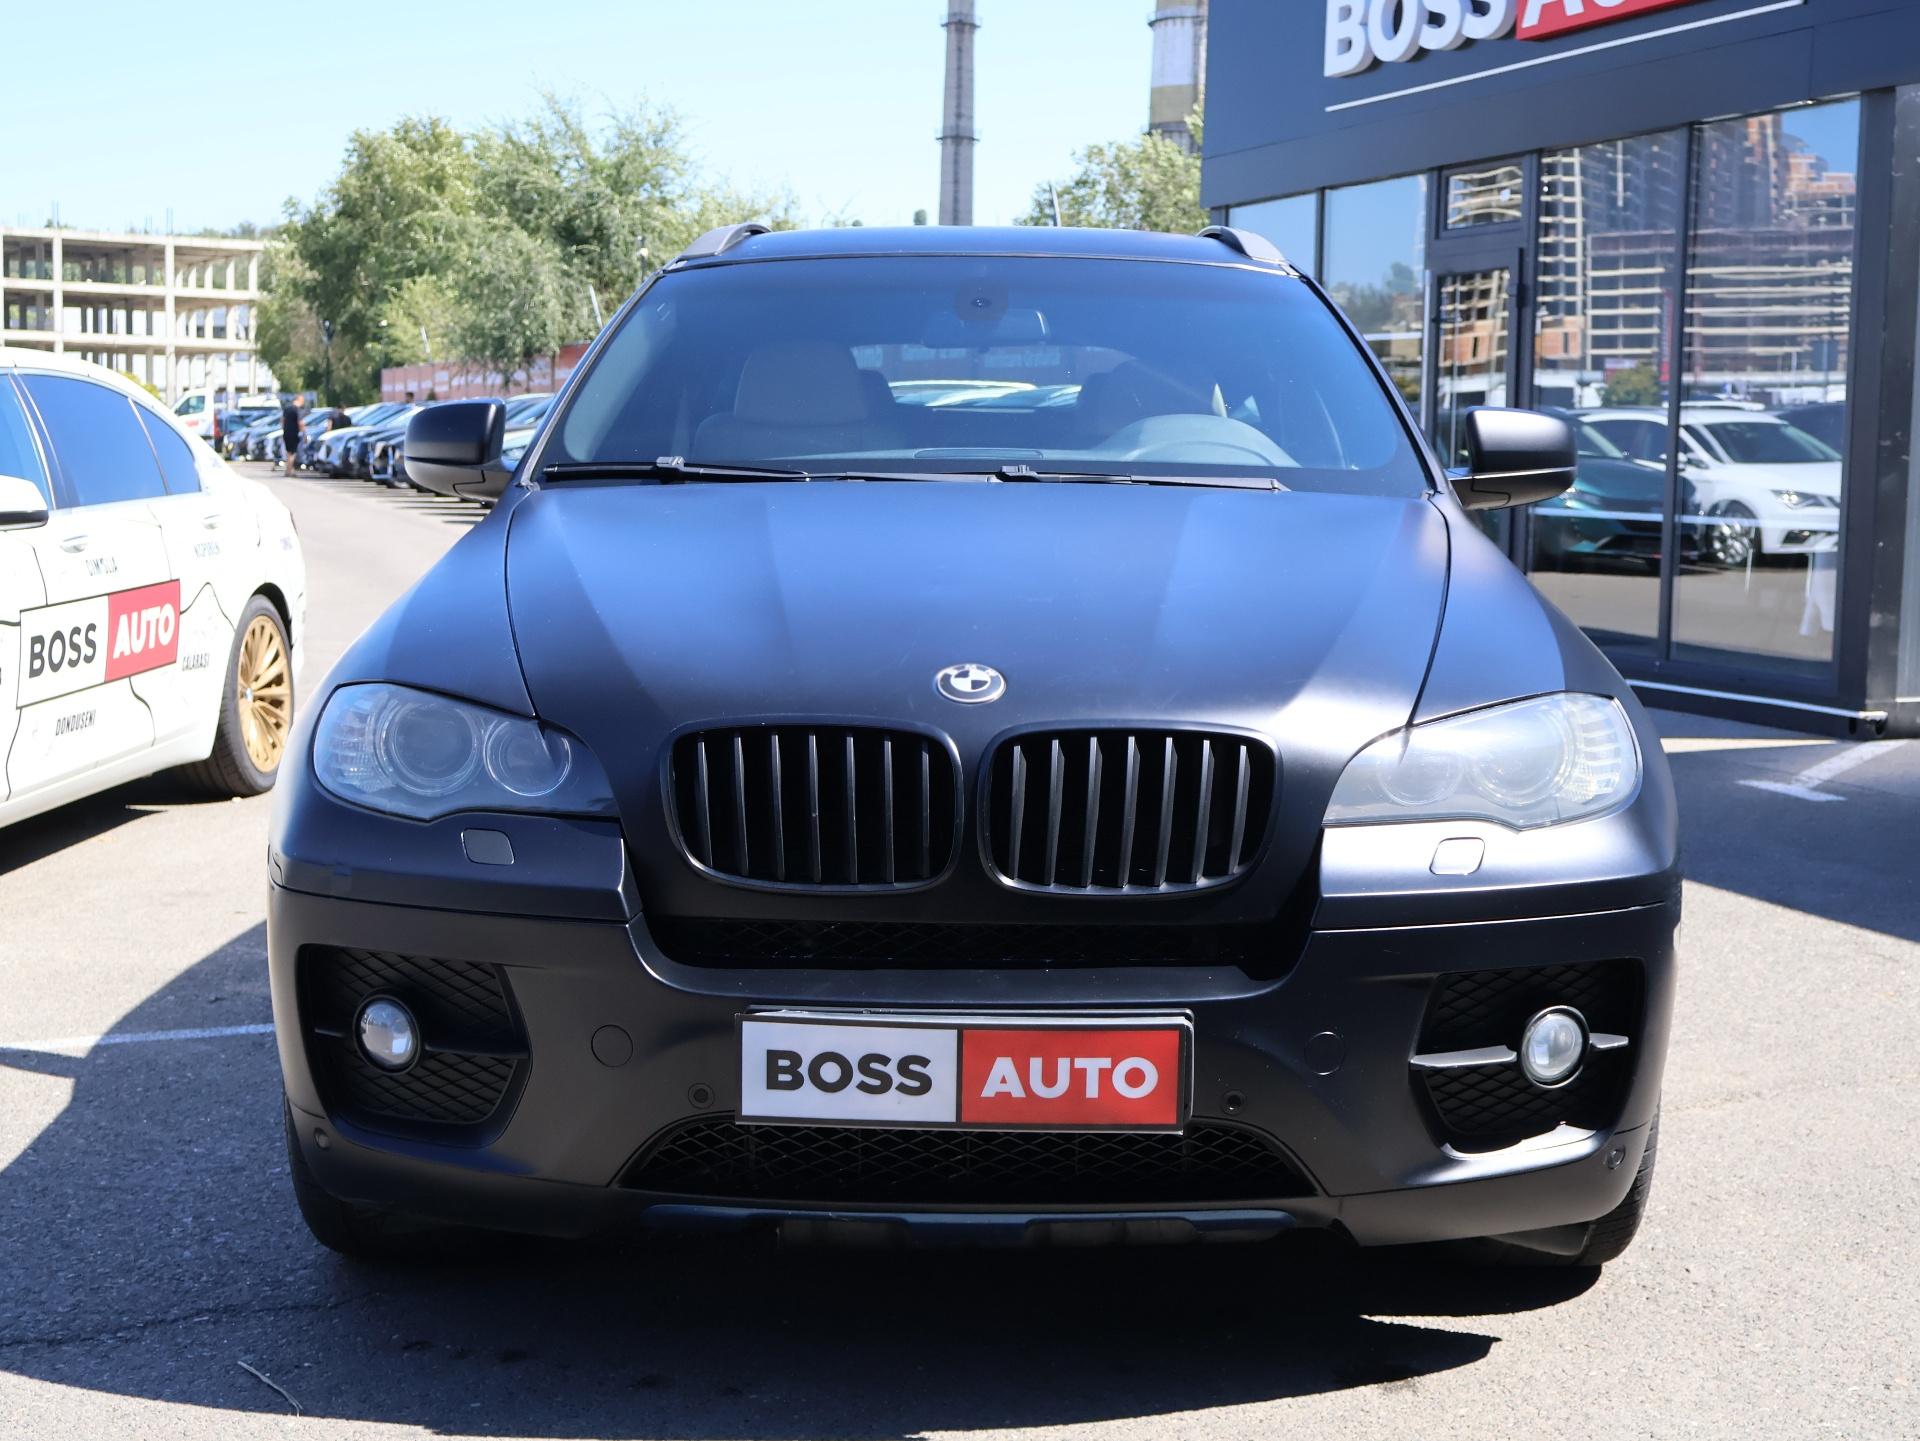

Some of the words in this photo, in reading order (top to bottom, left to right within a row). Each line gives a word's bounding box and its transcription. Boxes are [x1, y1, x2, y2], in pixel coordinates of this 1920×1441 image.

[29, 622, 97, 679] BOSS
[112, 603, 176, 660] AUTO
[765, 1048, 933, 1097] BOSS
[980, 1056, 1159, 1099] AUTO
